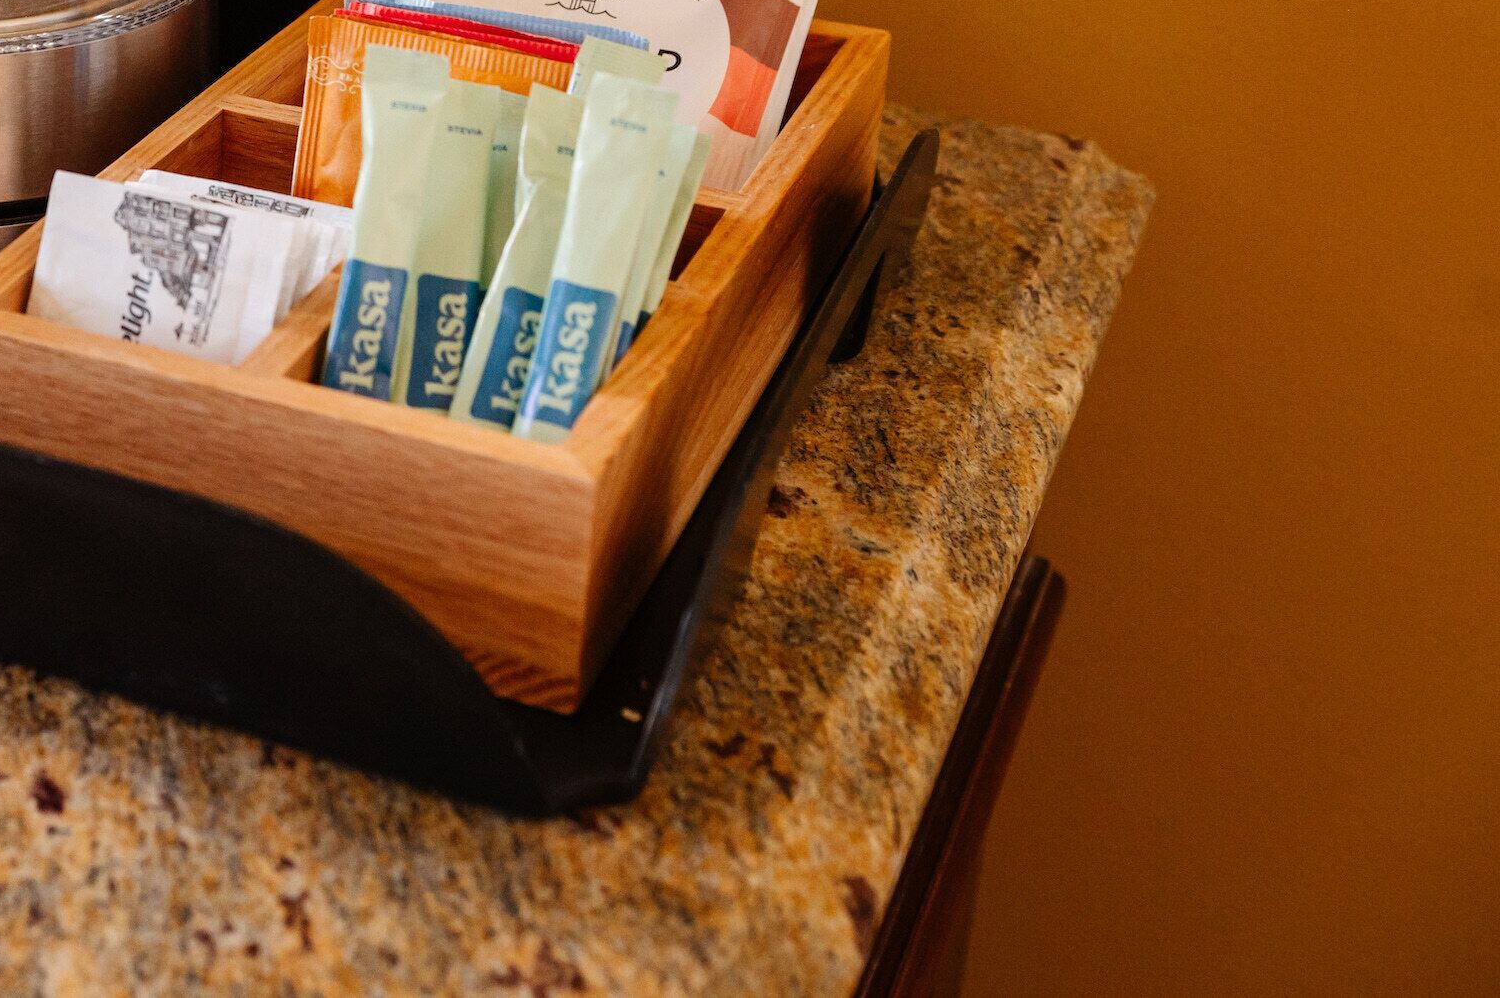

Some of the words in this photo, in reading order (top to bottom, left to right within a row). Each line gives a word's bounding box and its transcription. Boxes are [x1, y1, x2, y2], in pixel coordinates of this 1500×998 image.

[445, 124, 484, 137] STEVIA
[338, 279, 392, 391] kasa
[424, 291, 469, 398] kasa
[537, 300, 597, 416] kasa
